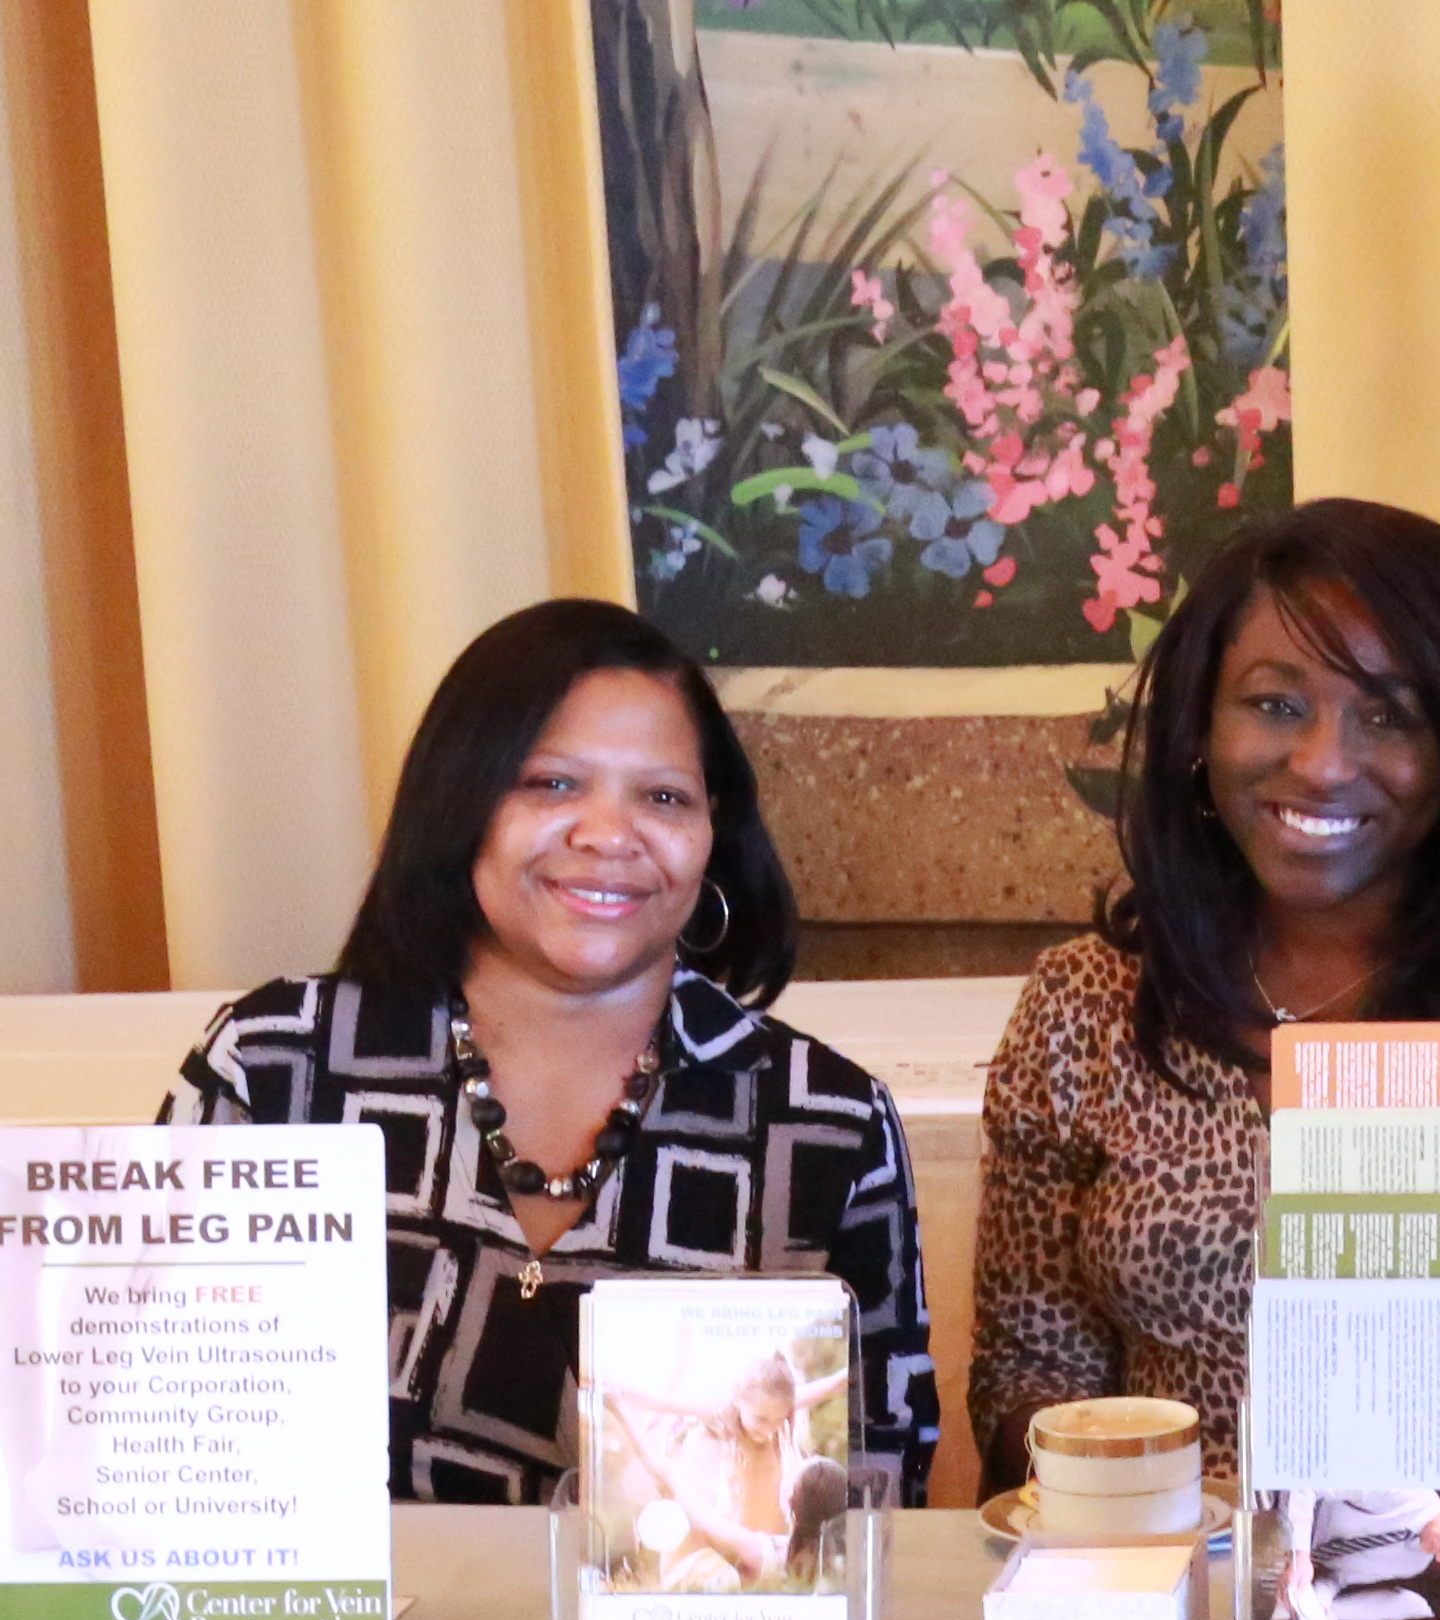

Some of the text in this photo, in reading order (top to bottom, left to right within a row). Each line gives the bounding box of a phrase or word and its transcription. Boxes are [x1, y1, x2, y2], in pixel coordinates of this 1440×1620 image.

[26, 1158, 320, 1191] BREAK FREE
[141, 1213, 230, 1245] LEG
[248, 1212, 354, 1243] PAIN
[84, 1285, 263, 1309] We bring FREE
[681, 1308, 705, 1318] WE
[711, 1308, 762, 1319] BRING
[768, 1308, 800, 1319] LEG
[70, 1315, 280, 1336] demonstrations of
[705, 1326, 760, 1337] RELIEF
[769, 1326, 788, 1337] TO
[13, 1345, 337, 1370] Lower Leg Vein Ultrasounds
[60, 1375, 292, 1399] to your Corporation,
[67, 1405, 286, 1428] Community Group,
[112, 1435, 242, 1457] Health Fair,
[96, 1466, 258, 1487] Senior Center,
[57, 1495, 299, 1519] School or University!
[59, 1549, 300, 1568] ASK US ABOUT IT!
[187, 1586, 382, 1616] Center for Vein
